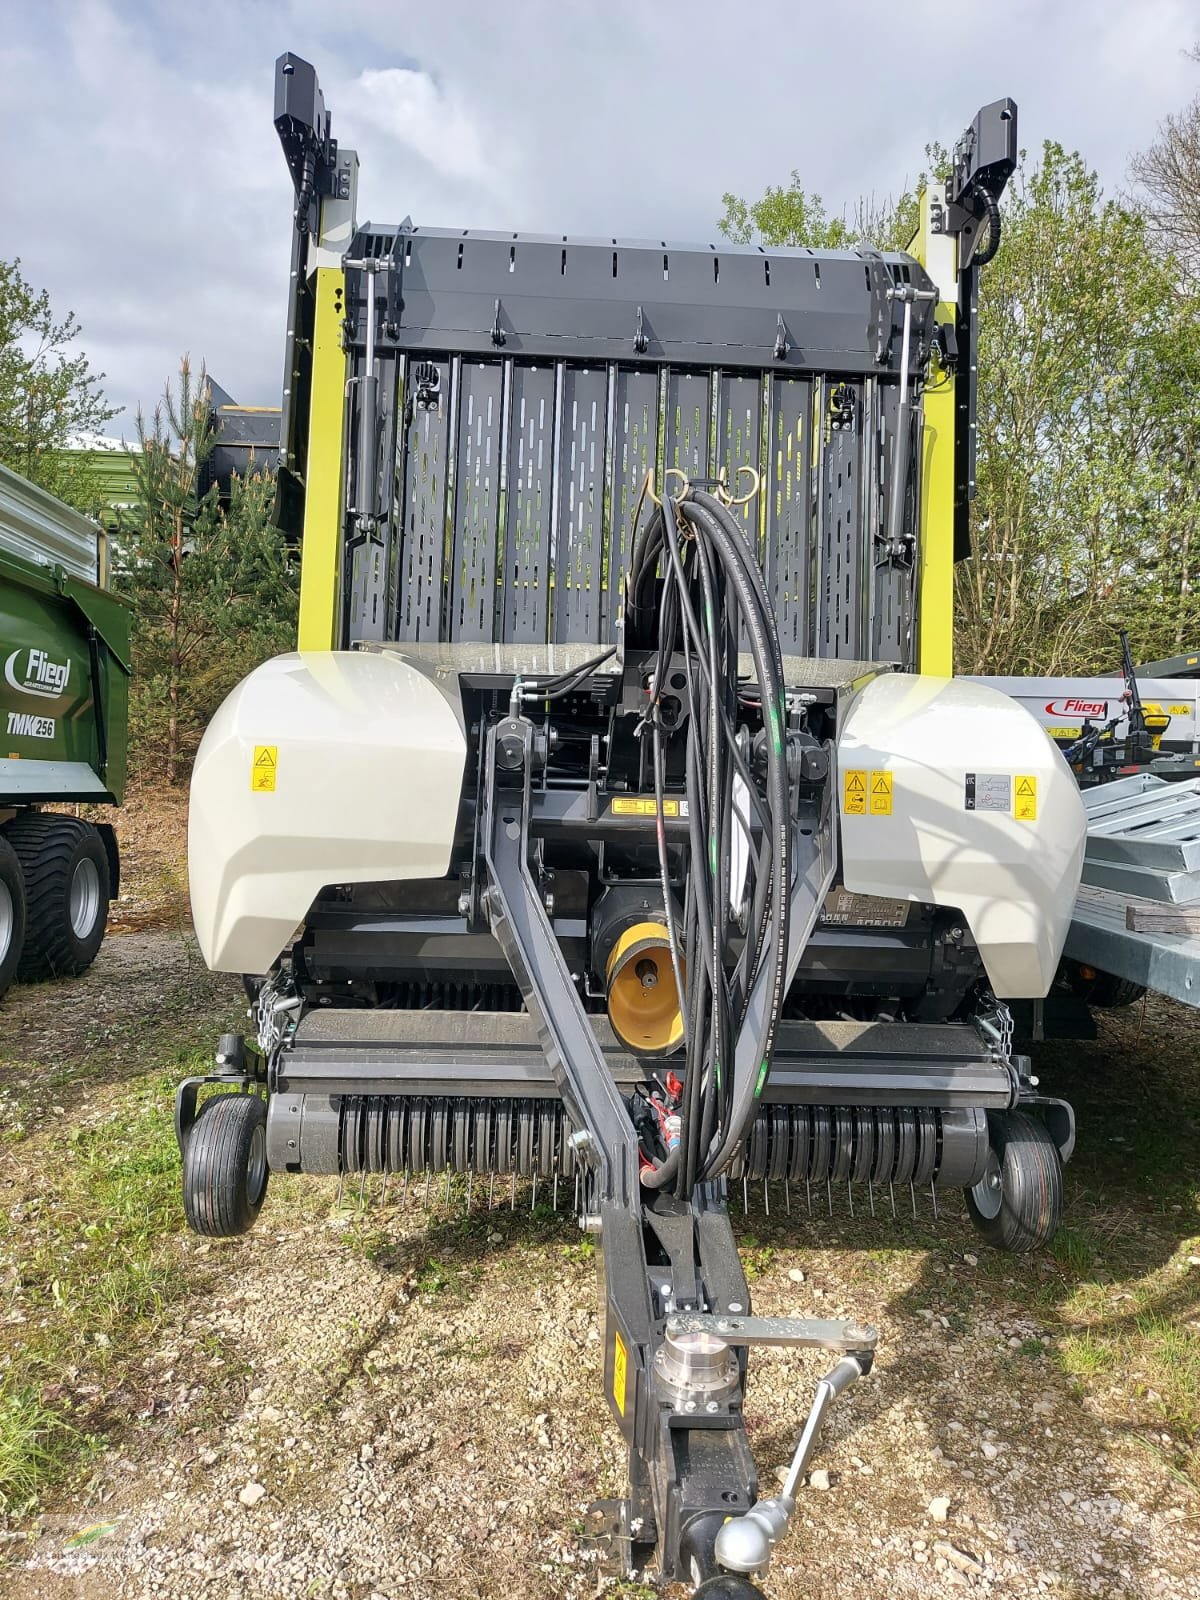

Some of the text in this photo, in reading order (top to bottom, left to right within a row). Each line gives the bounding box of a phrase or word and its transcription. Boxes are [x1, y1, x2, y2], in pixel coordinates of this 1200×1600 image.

[26, 648, 71, 693] Fliegl
[7, 711, 53, 736] TMK 256
